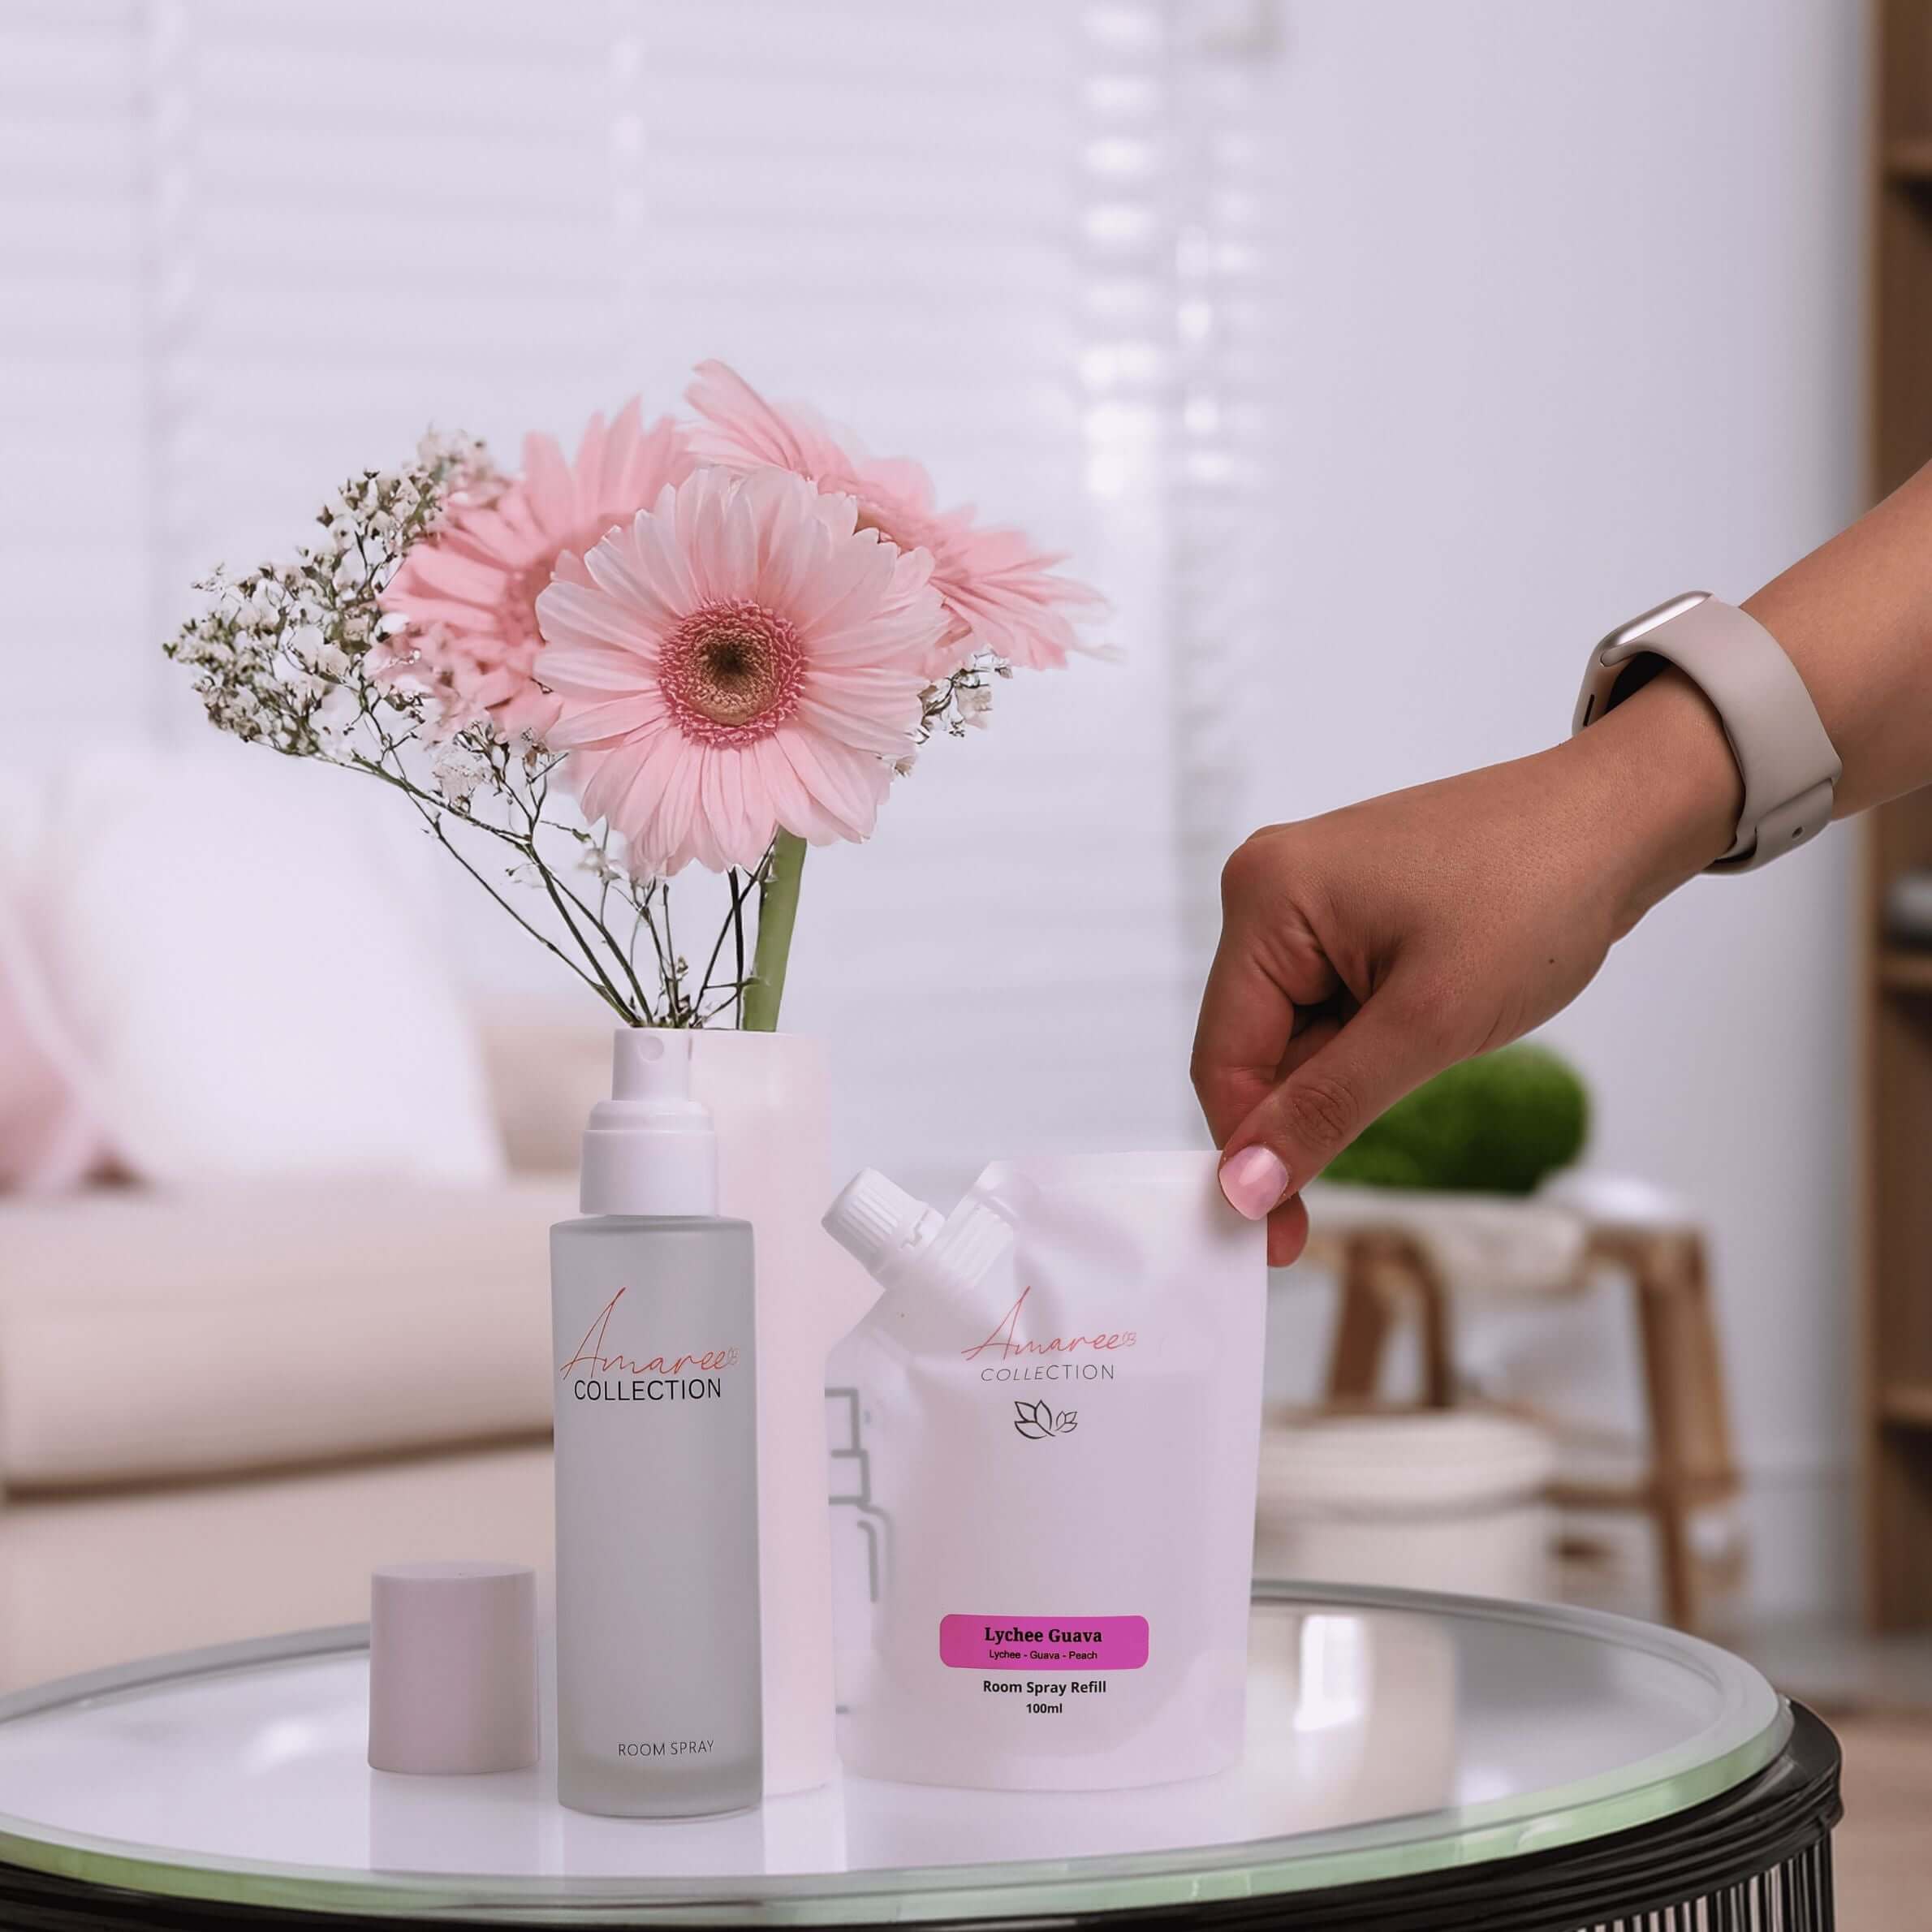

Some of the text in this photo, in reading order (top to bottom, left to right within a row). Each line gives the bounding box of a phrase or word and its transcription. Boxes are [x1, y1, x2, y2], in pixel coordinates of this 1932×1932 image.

[961, 1285, 1119, 1361] Amaree
[559, 1286, 727, 1380] Amaree
[981, 1364, 1114, 1382] COLLECTION
[574, 1378, 722, 1401] COLLECTION
[985, 1627, 1102, 1645] Lychee Guava
[989, 1650, 1021, 1659] Lychee
[1029, 1650, 1060, 1659] Guava
[1068, 1651, 1098, 1660] Peach
[983, 1680, 1106, 1697] Room Spray Refill
[1026, 1703, 1063, 1714] 100ml
[618, 1740, 714, 1757] ROOM SPRAY
